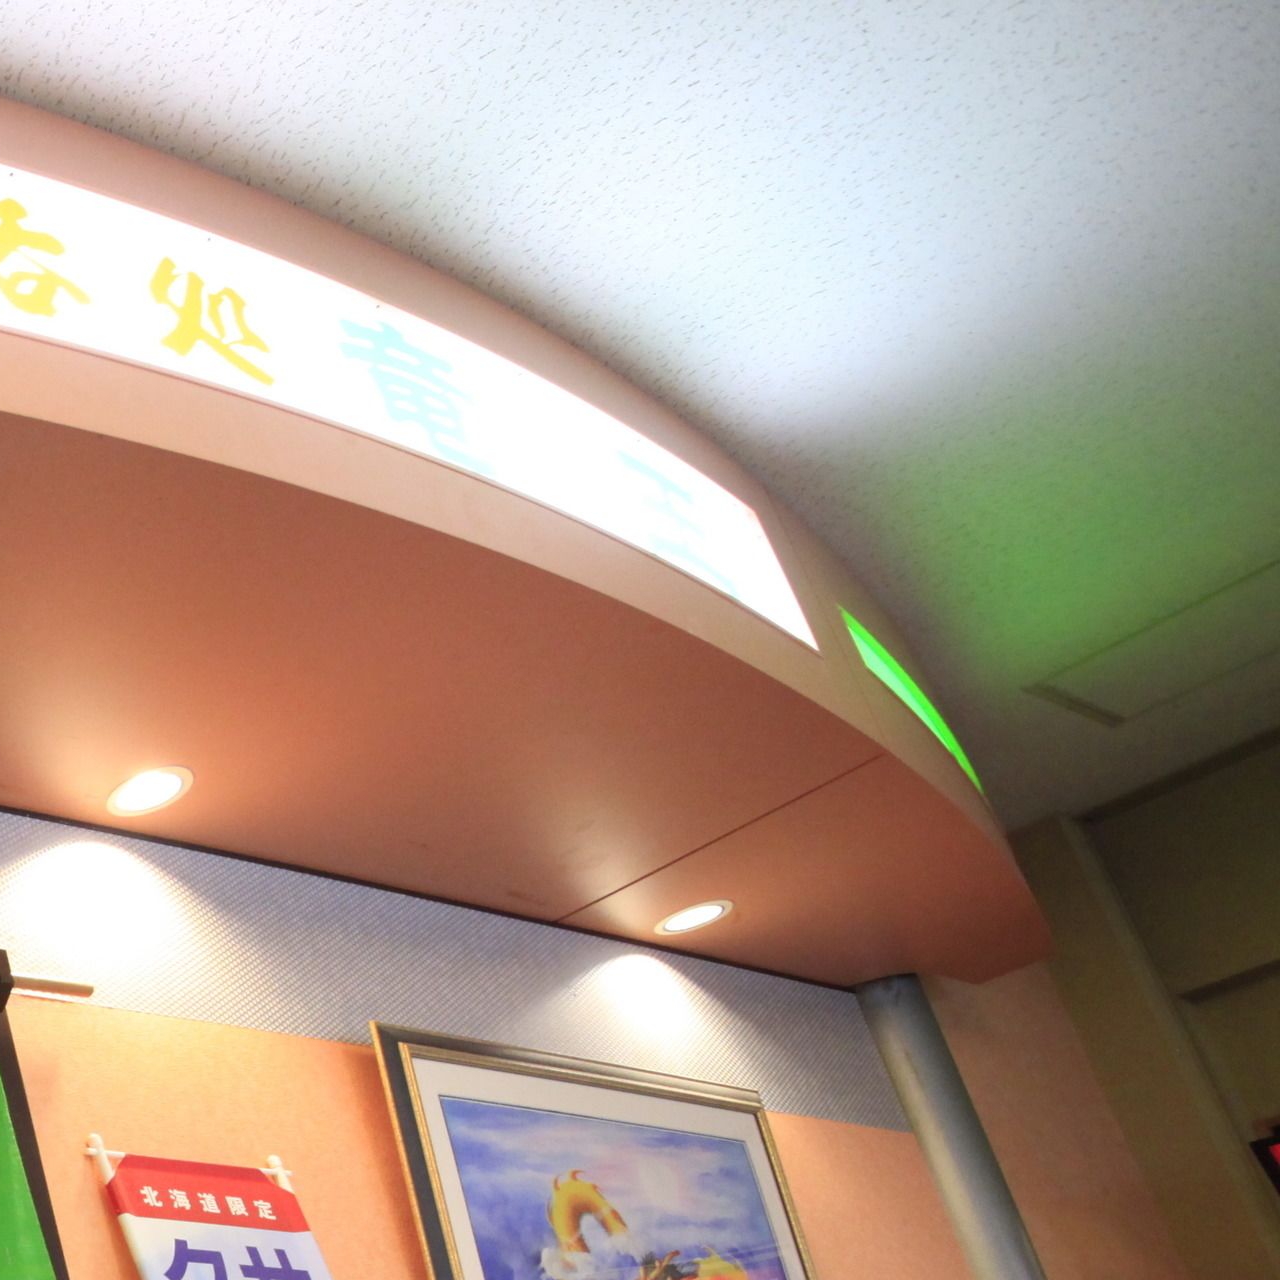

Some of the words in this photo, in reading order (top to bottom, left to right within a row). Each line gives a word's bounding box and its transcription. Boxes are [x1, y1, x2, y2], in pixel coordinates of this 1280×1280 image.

[140, 1184, 278, 1221] 北海道限定
